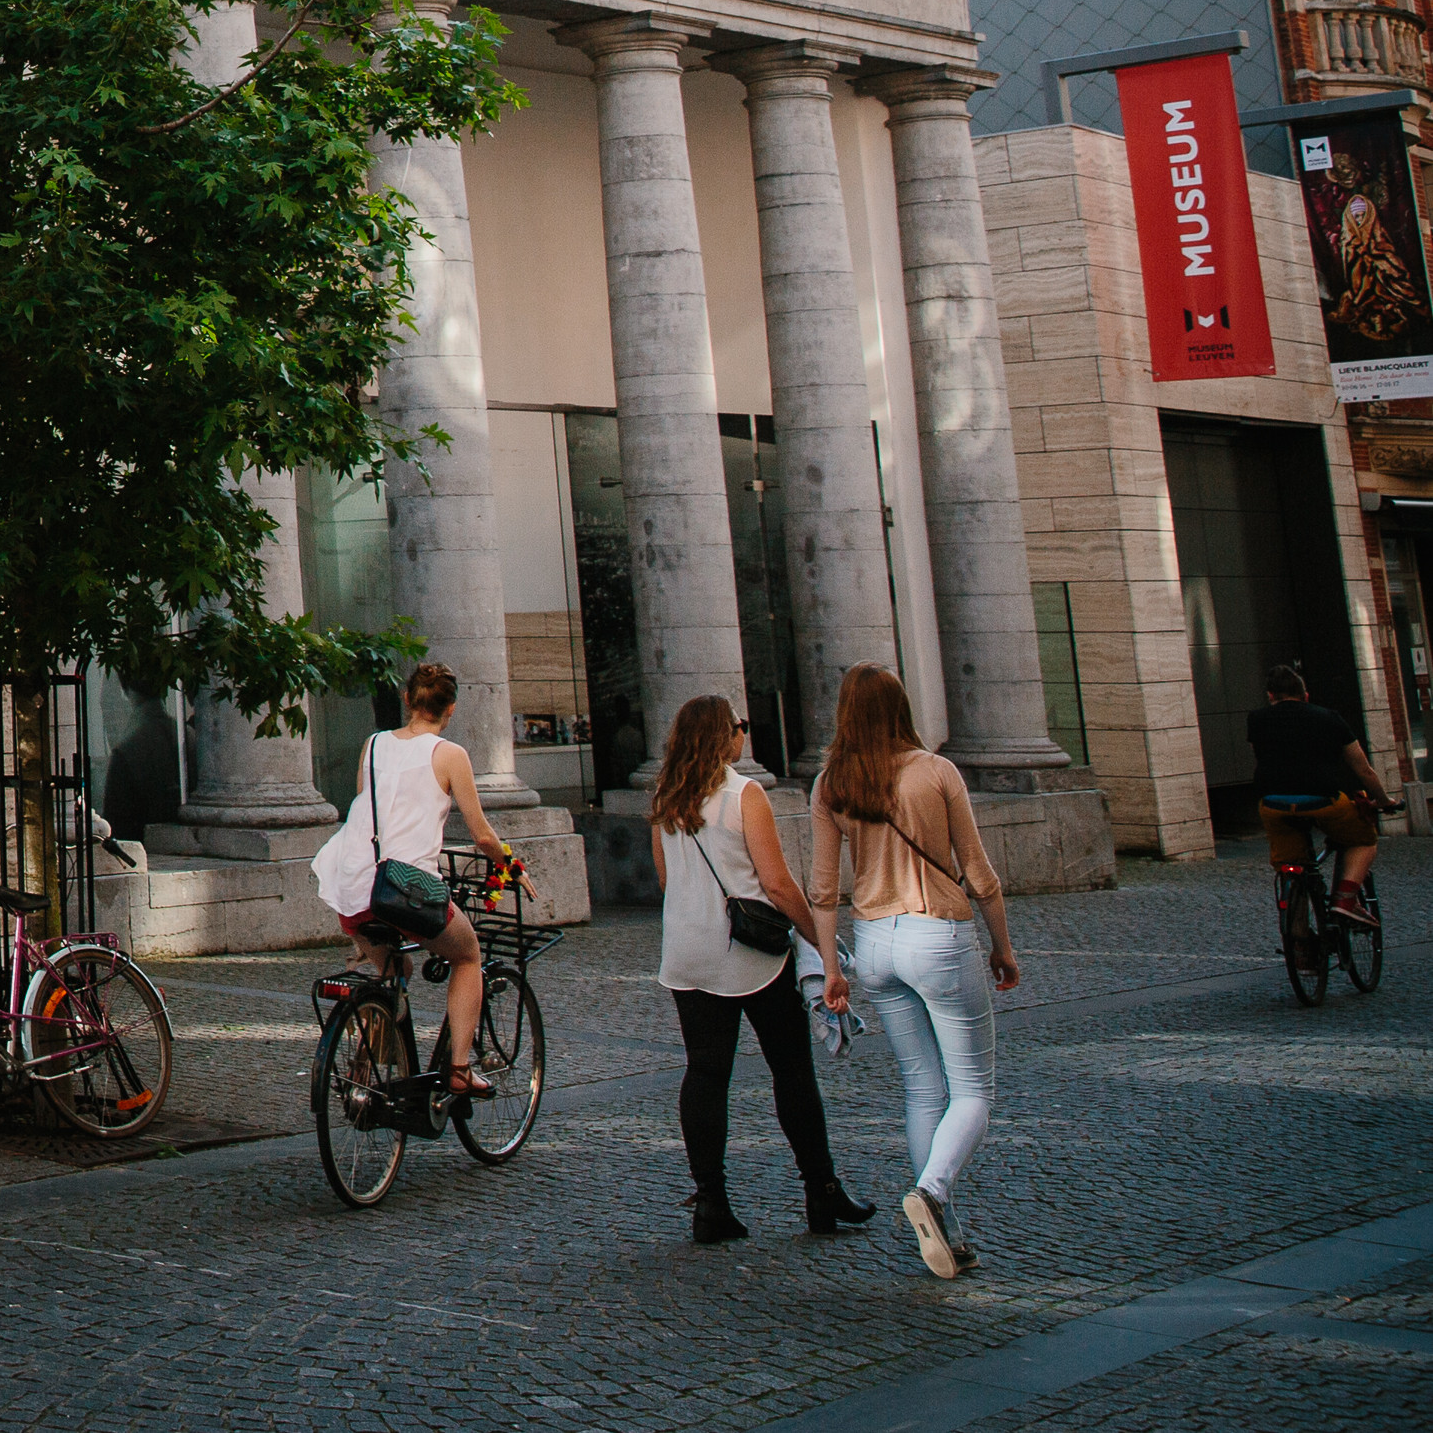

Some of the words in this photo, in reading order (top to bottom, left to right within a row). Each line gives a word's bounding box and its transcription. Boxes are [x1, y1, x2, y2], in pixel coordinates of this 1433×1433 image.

[1162, 99, 1215, 276] MUSEUM
[1188, 343, 1233, 353] MUSEUM
[1189, 352, 1235, 362] LEUVEN
[1338, 366, 1361, 374] LIEVE
[1364, 361, 1429, 372] BLANCQUAERT
